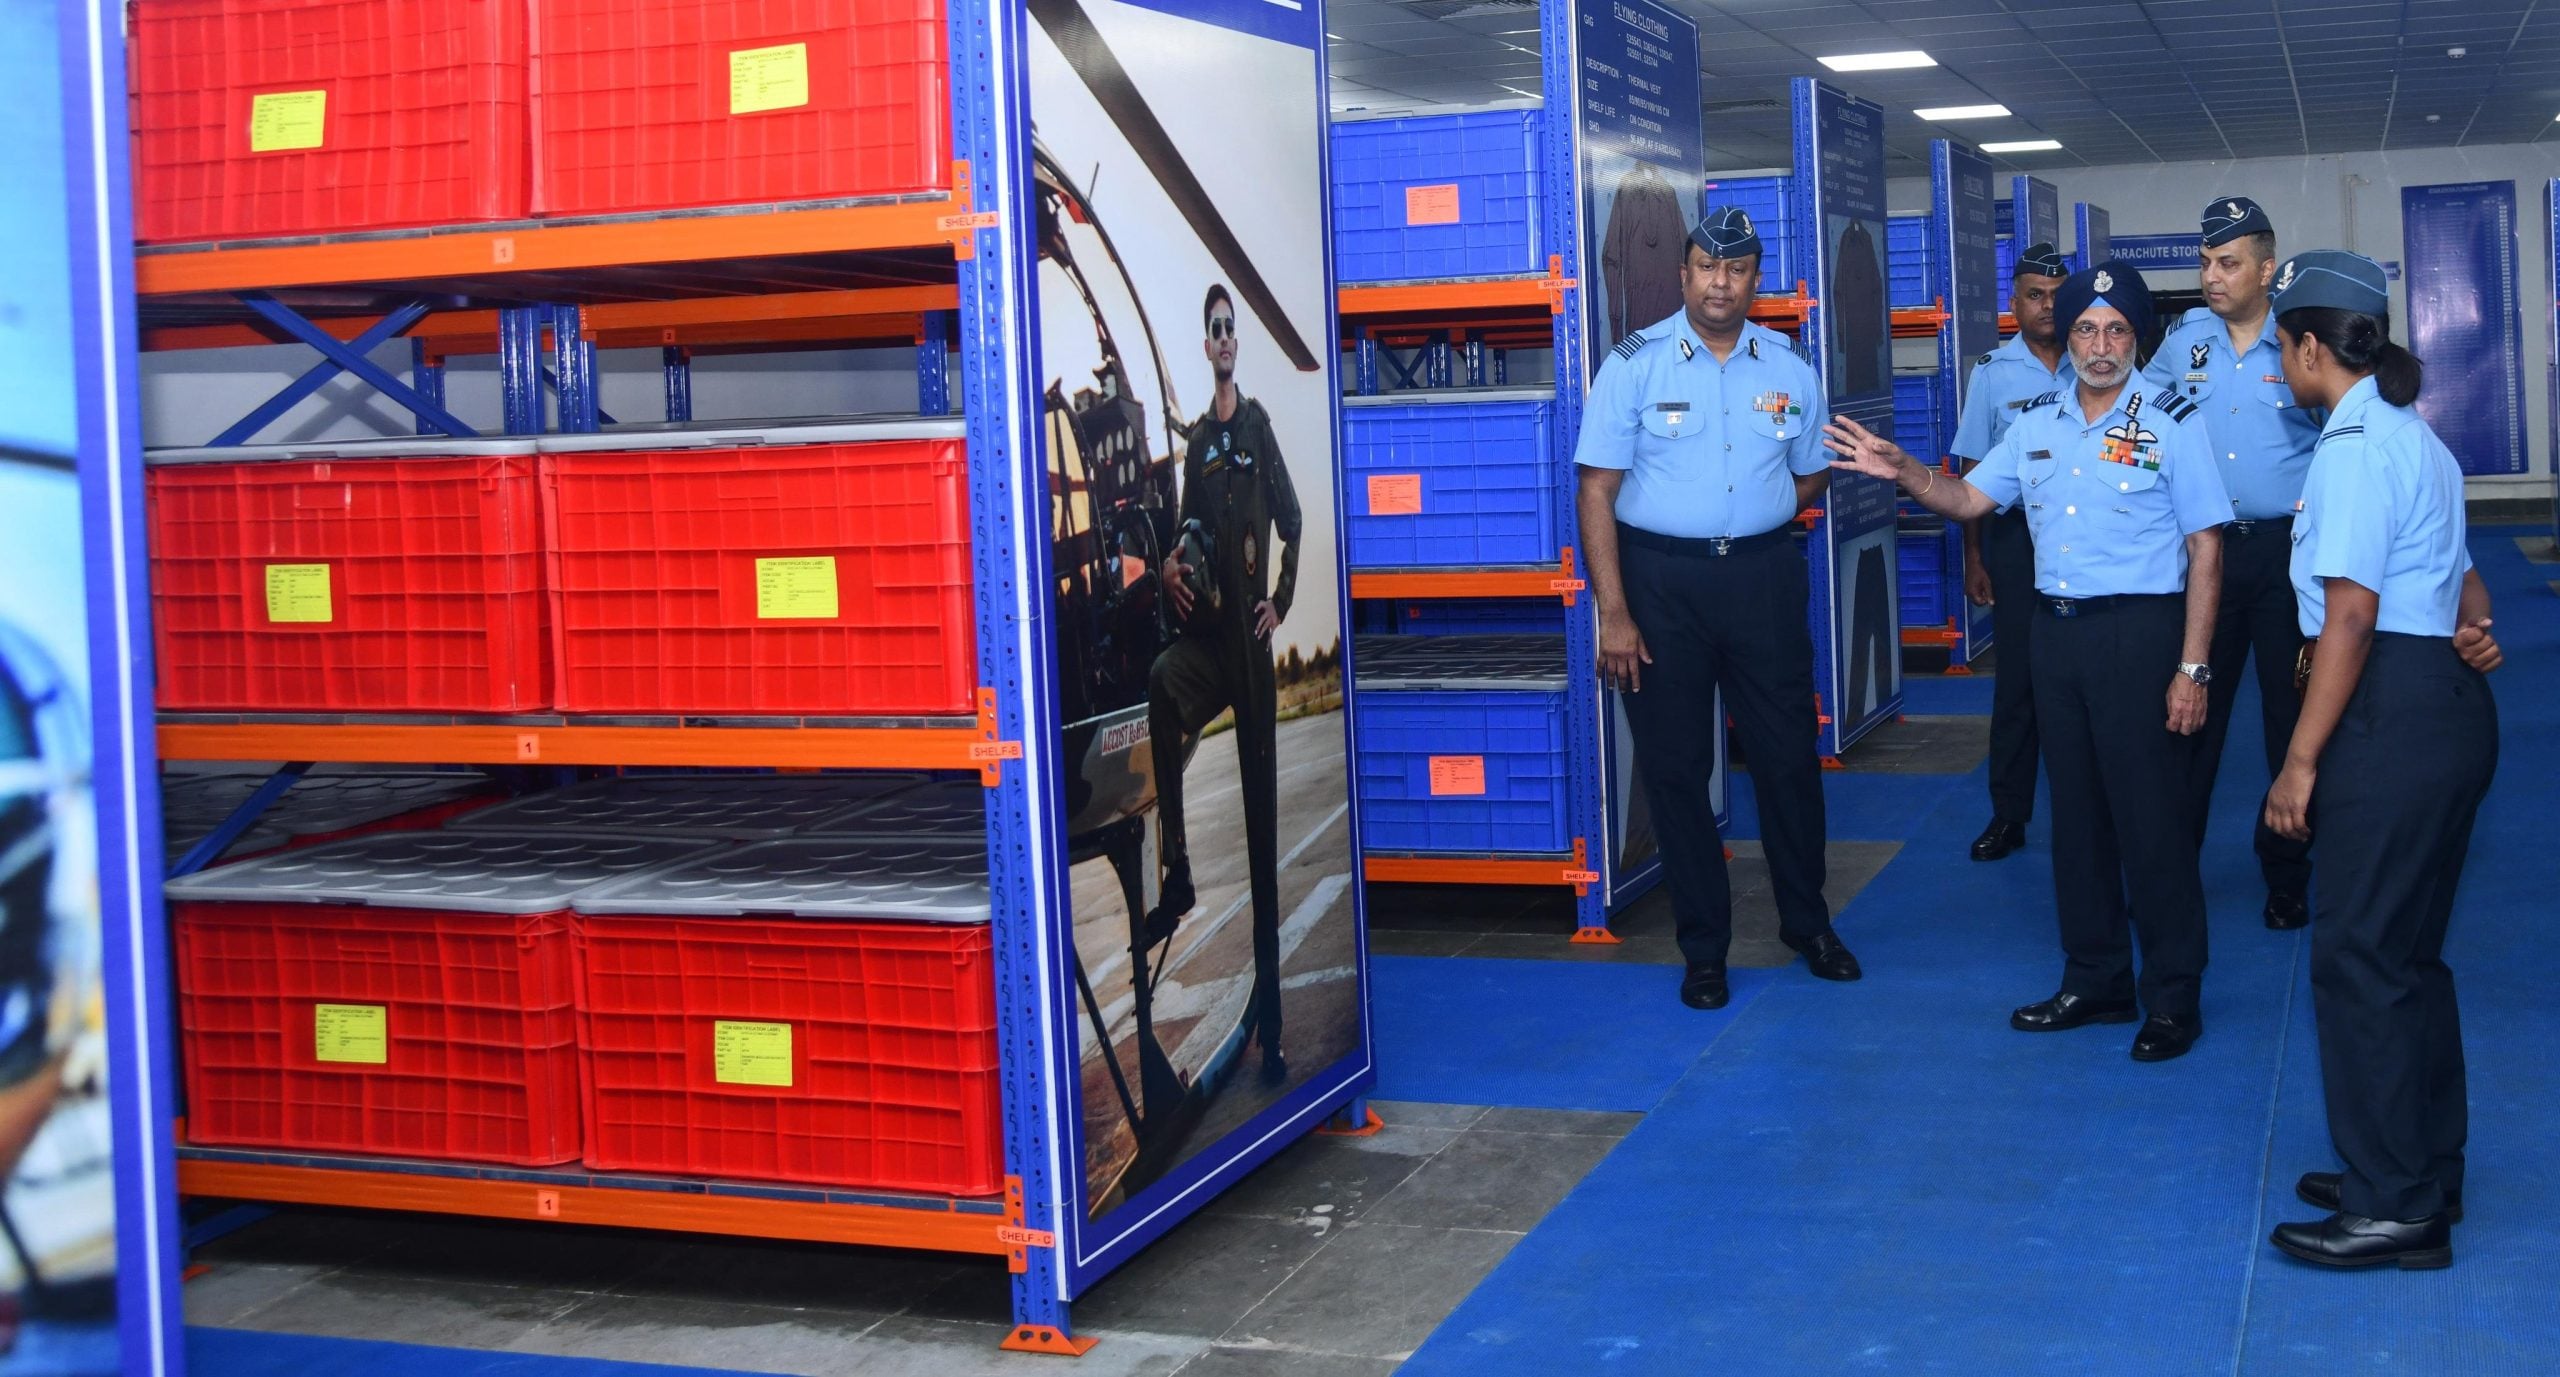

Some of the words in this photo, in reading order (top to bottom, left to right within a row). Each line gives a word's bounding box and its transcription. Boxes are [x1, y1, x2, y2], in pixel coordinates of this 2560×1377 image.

[1613, 1, 1637, 24] FLYING
[1637, 13, 1669, 39] CLOTHING
[1585, 56, 1620, 80] DESCRIPTION
[1628, 74, 1650, 92] THERMAL
[1650, 83, 1662, 96] VEST
[1586, 78, 1599, 92] SIZE
[1587, 98, 1604, 113] SHELF
[1604, 104, 1616, 118] LIFE
[1629, 113, 1637, 125] ON
[1637, 116, 1662, 134] CONDITION
[945, 215, 978, 227] SHELF
[988, 214, 994, 223] A
[500, 246, 506, 257] 1
[2172, 245, 2200, 257] STOR
[525, 742, 531, 753] 1
[544, 1199, 551, 1210] 1
[1000, 1230, 1034, 1242] SHELF
[1043, 1235, 1051, 1245] C
